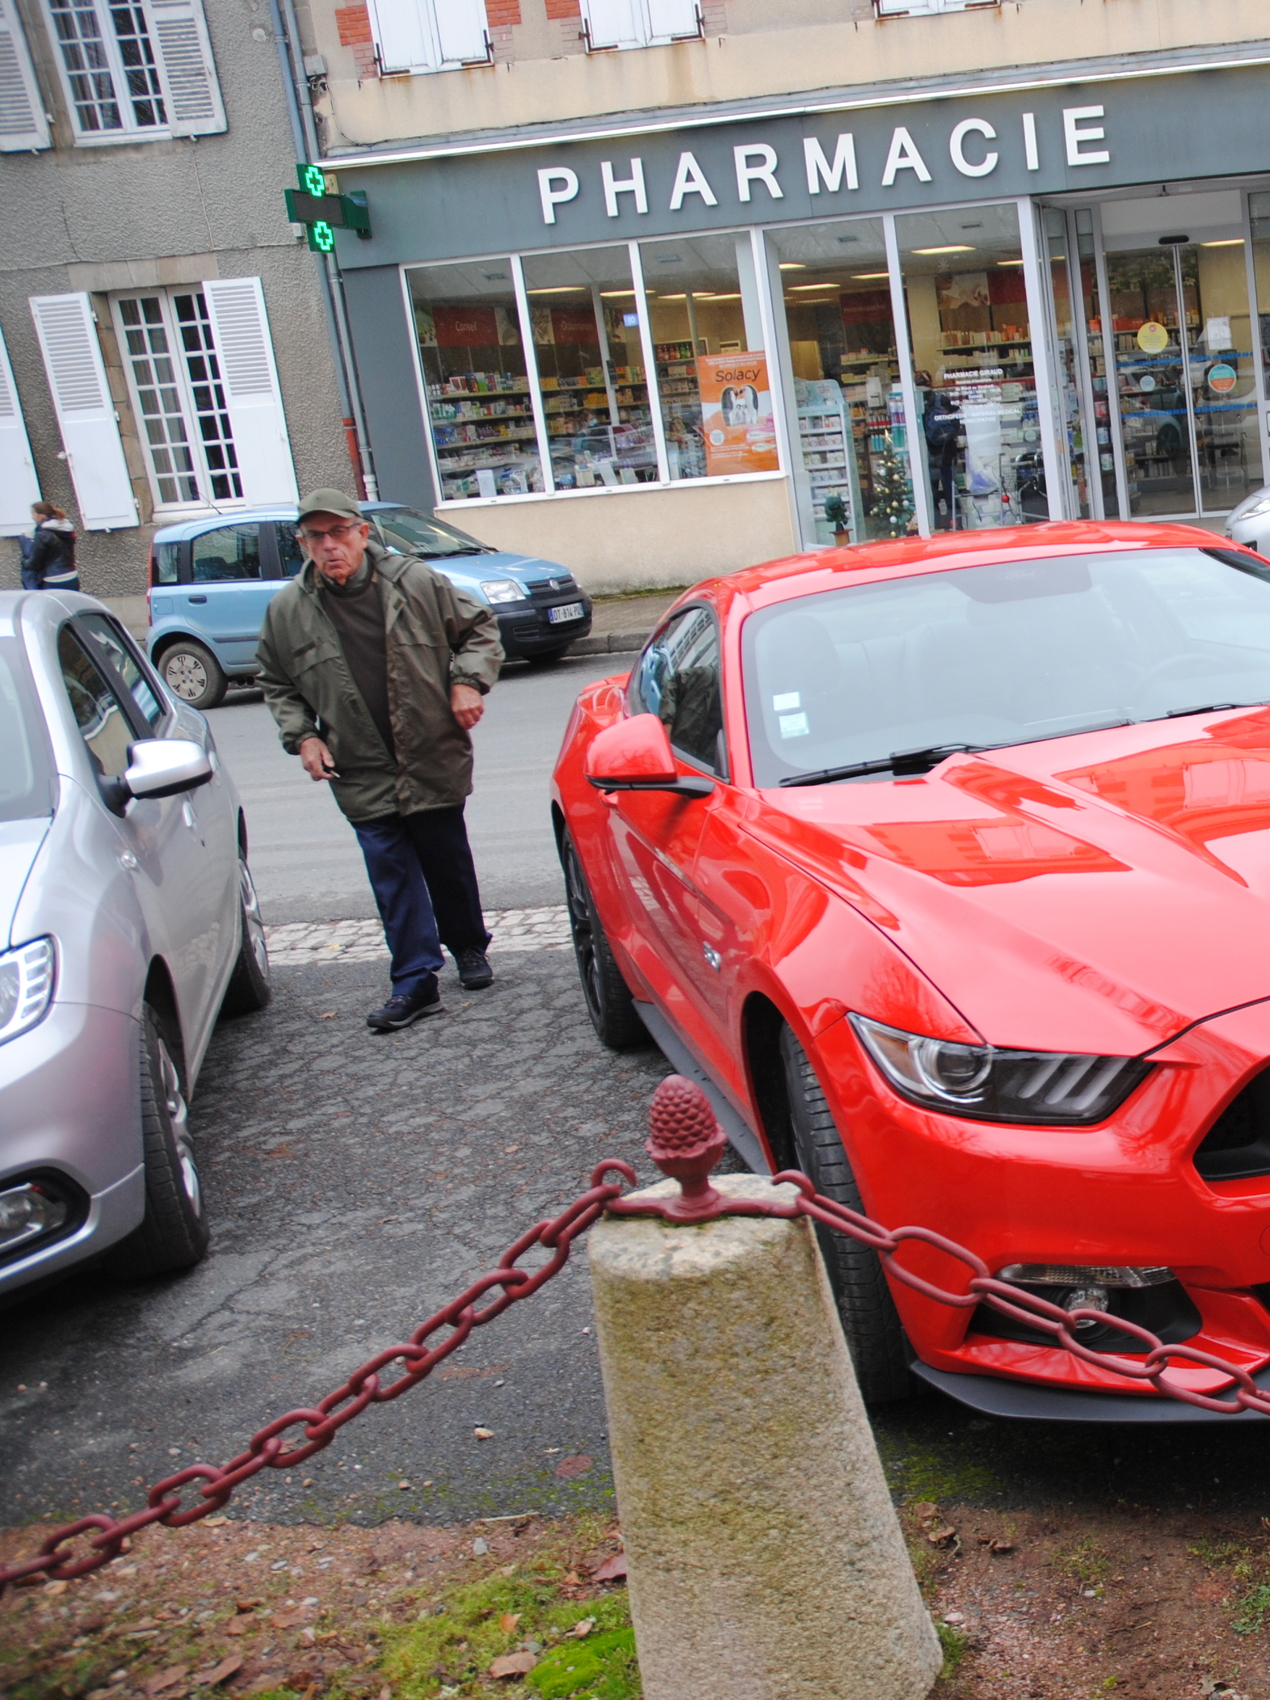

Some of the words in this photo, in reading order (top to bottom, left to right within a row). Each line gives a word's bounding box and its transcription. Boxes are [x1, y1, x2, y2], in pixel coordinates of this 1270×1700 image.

[537, 105, 1111, 224] PHARMACIE
[455, 321, 478, 332] Conseil
[715, 368, 761, 383] Solacy
[943, 370, 979, 379] PHARMACIE
[979, 368, 1003, 377] GIRAUD
[997, 408, 1020, 416] MEDICAL
